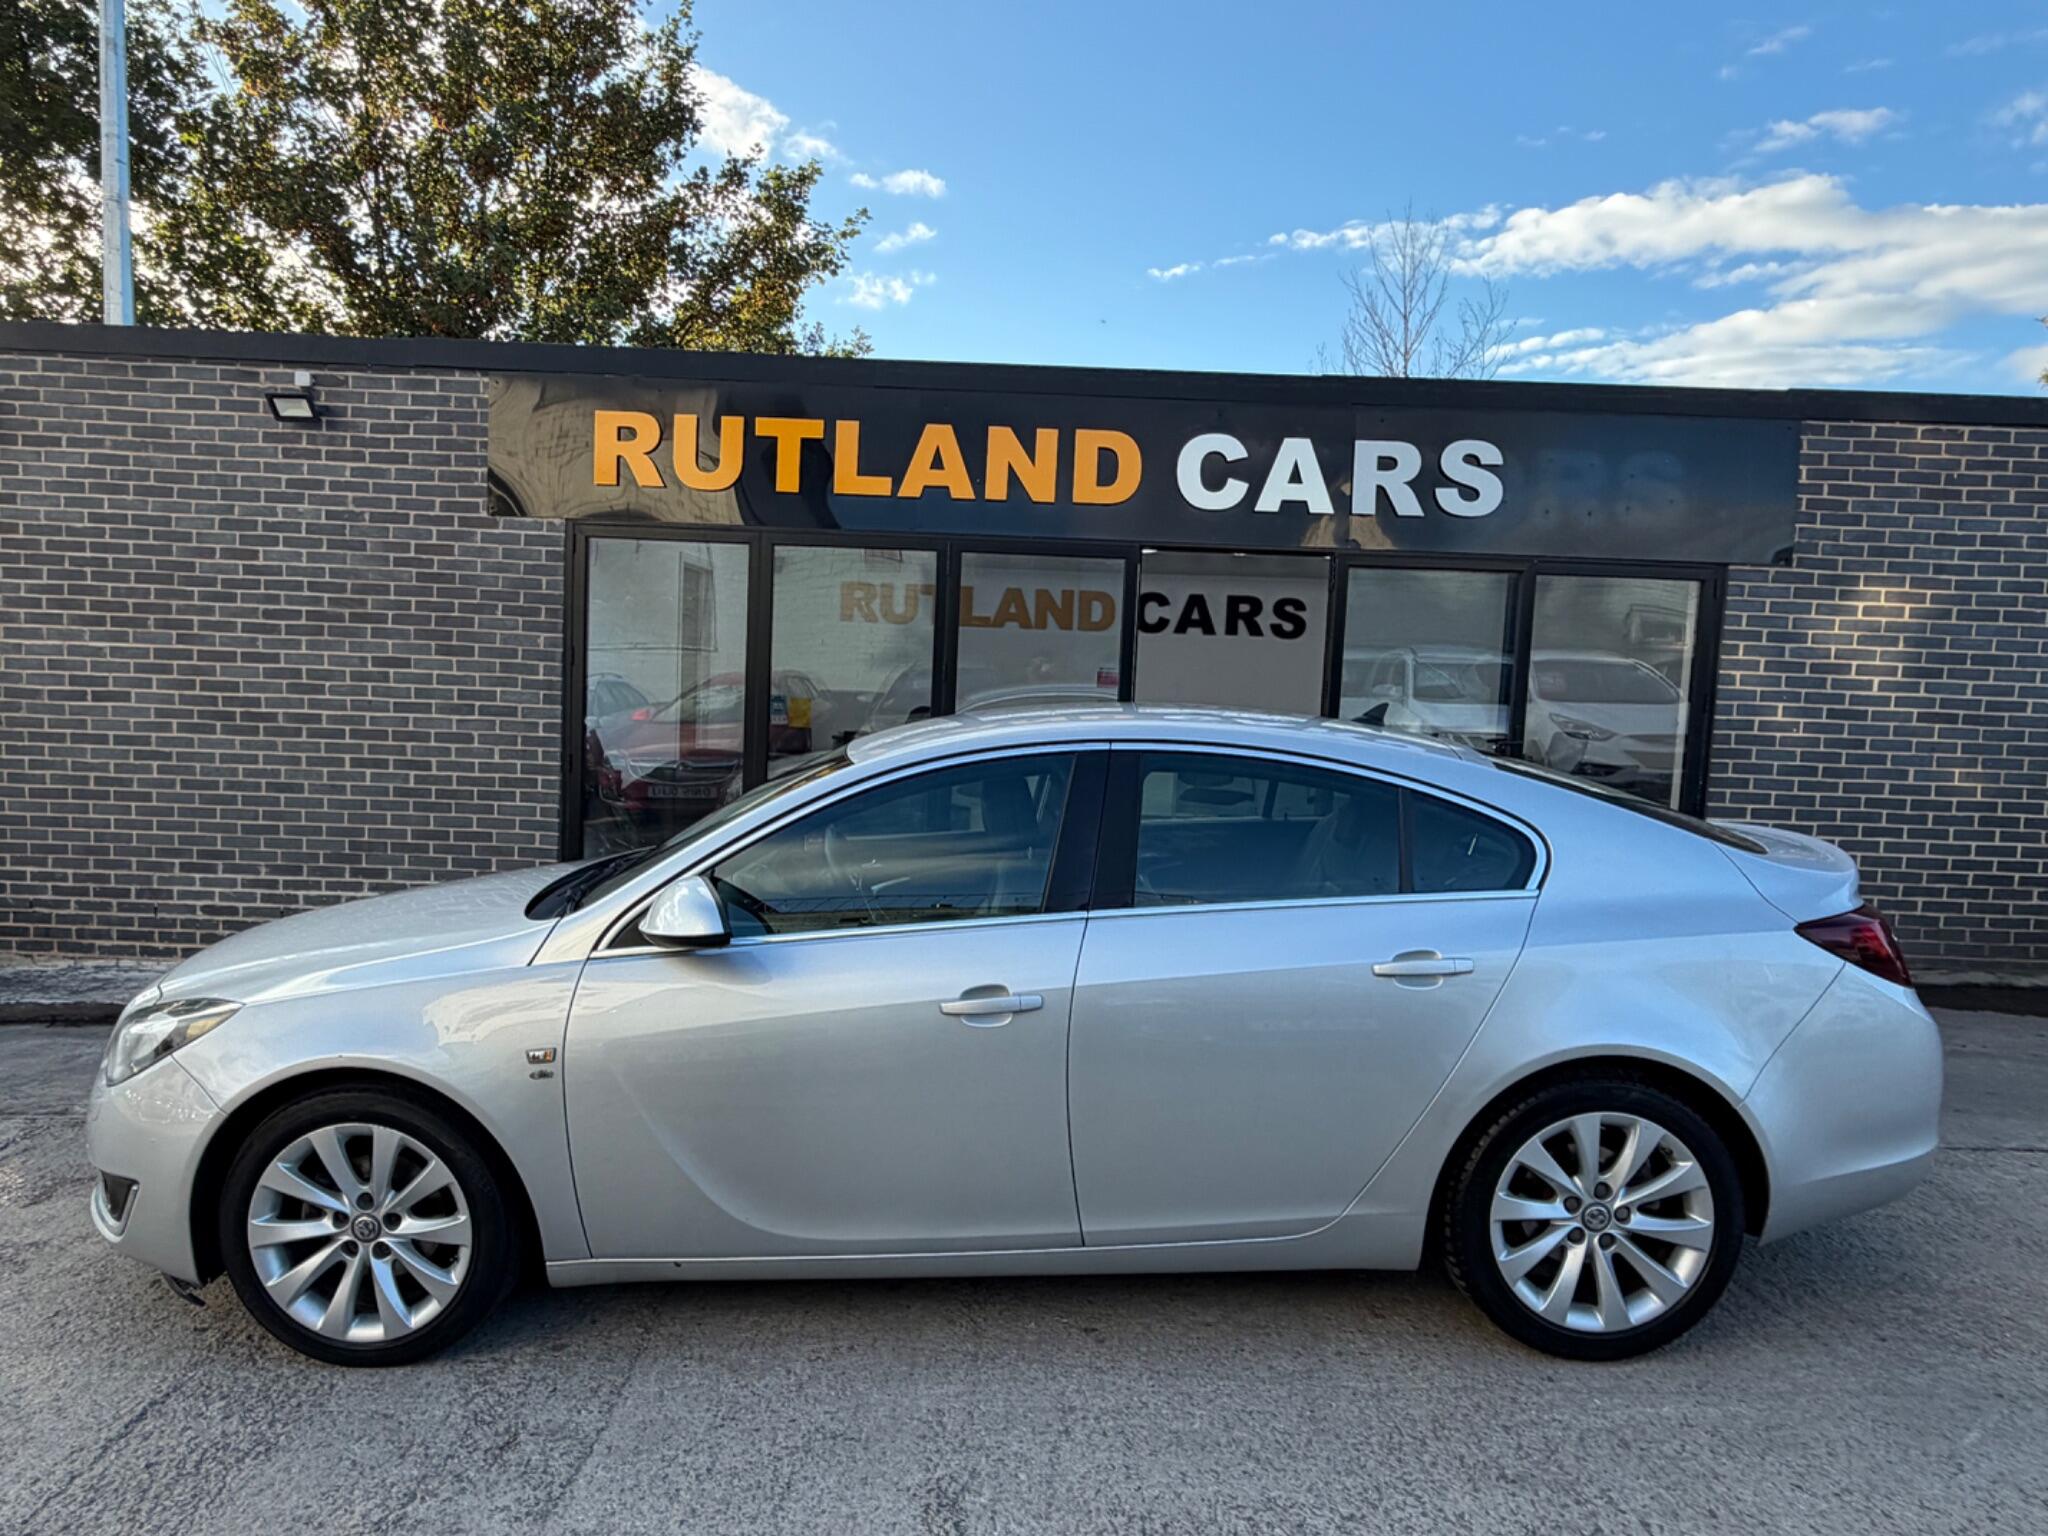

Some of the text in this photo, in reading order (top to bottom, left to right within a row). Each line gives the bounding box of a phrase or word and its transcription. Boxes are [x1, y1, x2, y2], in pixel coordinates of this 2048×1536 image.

[593, 409, 1505, 517] RUTLAND CARS
[1137, 590, 1308, 640] CARS
